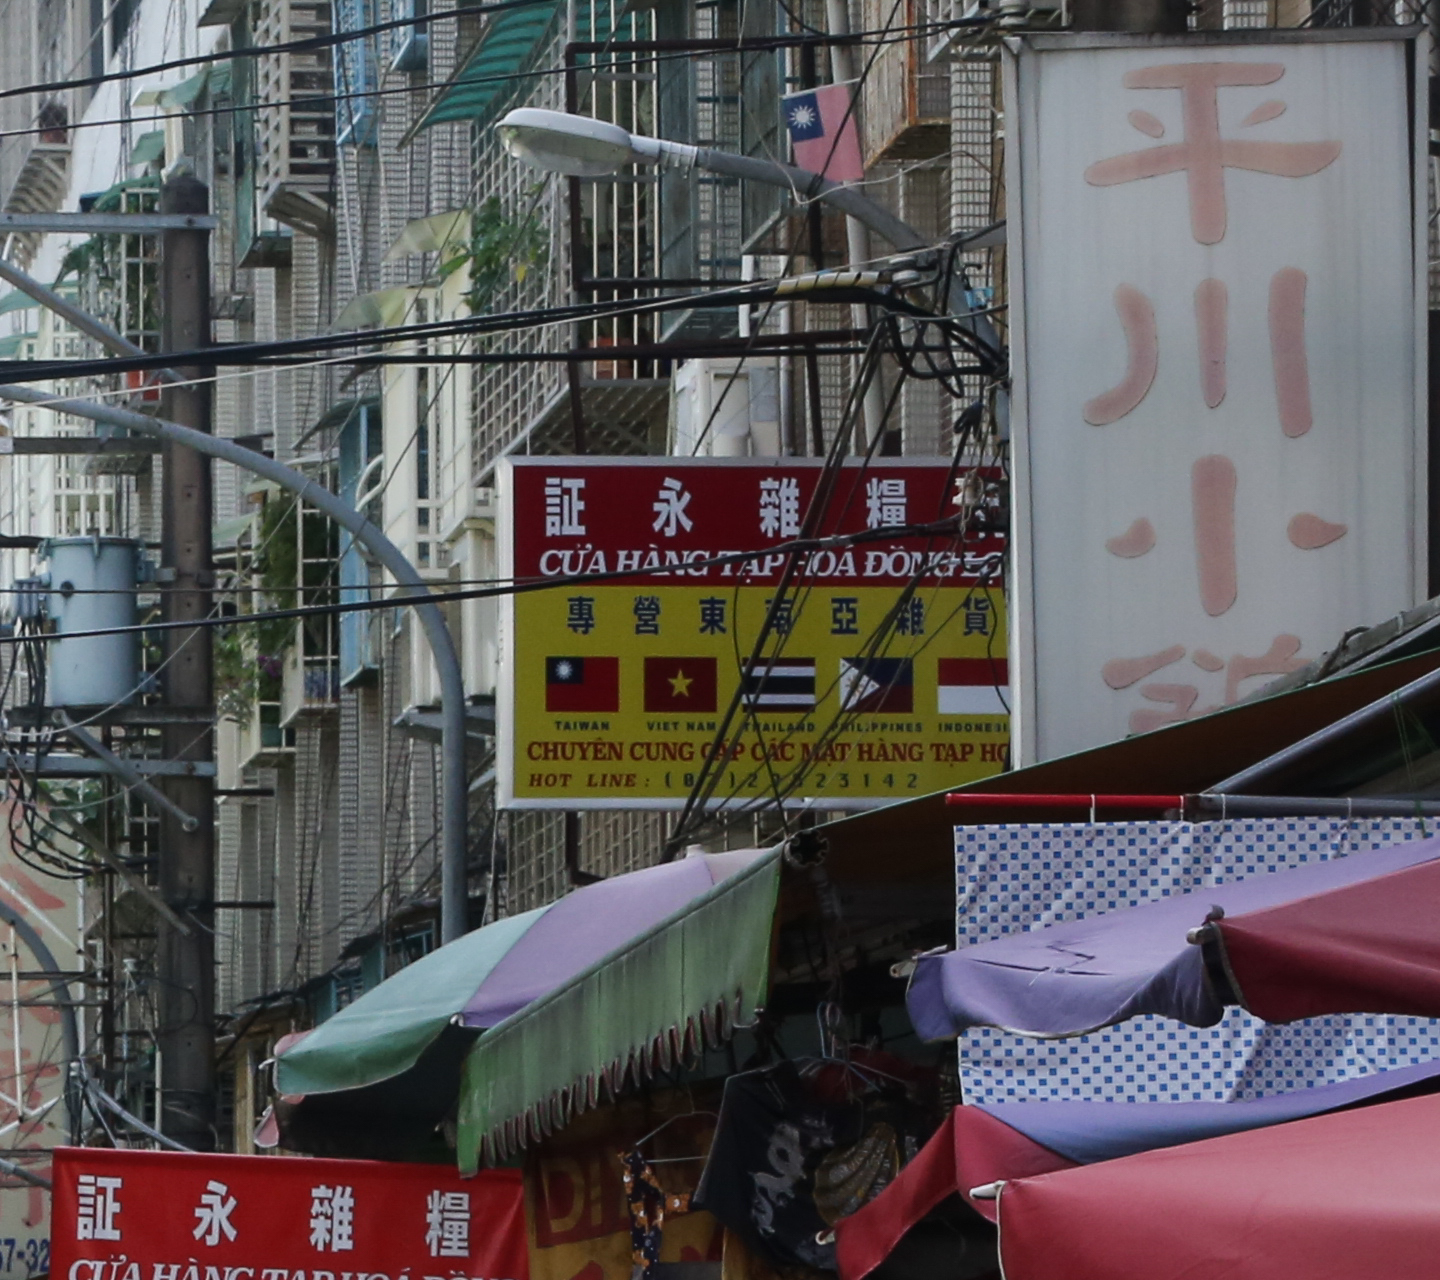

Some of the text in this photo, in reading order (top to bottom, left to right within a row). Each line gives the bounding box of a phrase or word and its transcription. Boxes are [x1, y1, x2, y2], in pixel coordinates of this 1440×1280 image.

[615, 545, 712, 578] HÀNG
[719, 550, 784, 584] TẠP
[566, 596, 990, 637] 專營東南亞雜貨
[555, 720, 611, 731] TAIWAN
[646, 721, 717, 732] VIET NAM
[744, 721, 816, 733] THAILAND
[832, 722, 923, 733] PHILIPPINES
[527, 738, 623, 762] CHUYÊN
[630, 740, 694, 762] CUNG
[857, 738, 924, 763] HÀNG
[930, 742, 974, 767] TẠP
[529, 773, 572, 787] HOT
[76, 1174, 471, 1257] 証永雜糧
